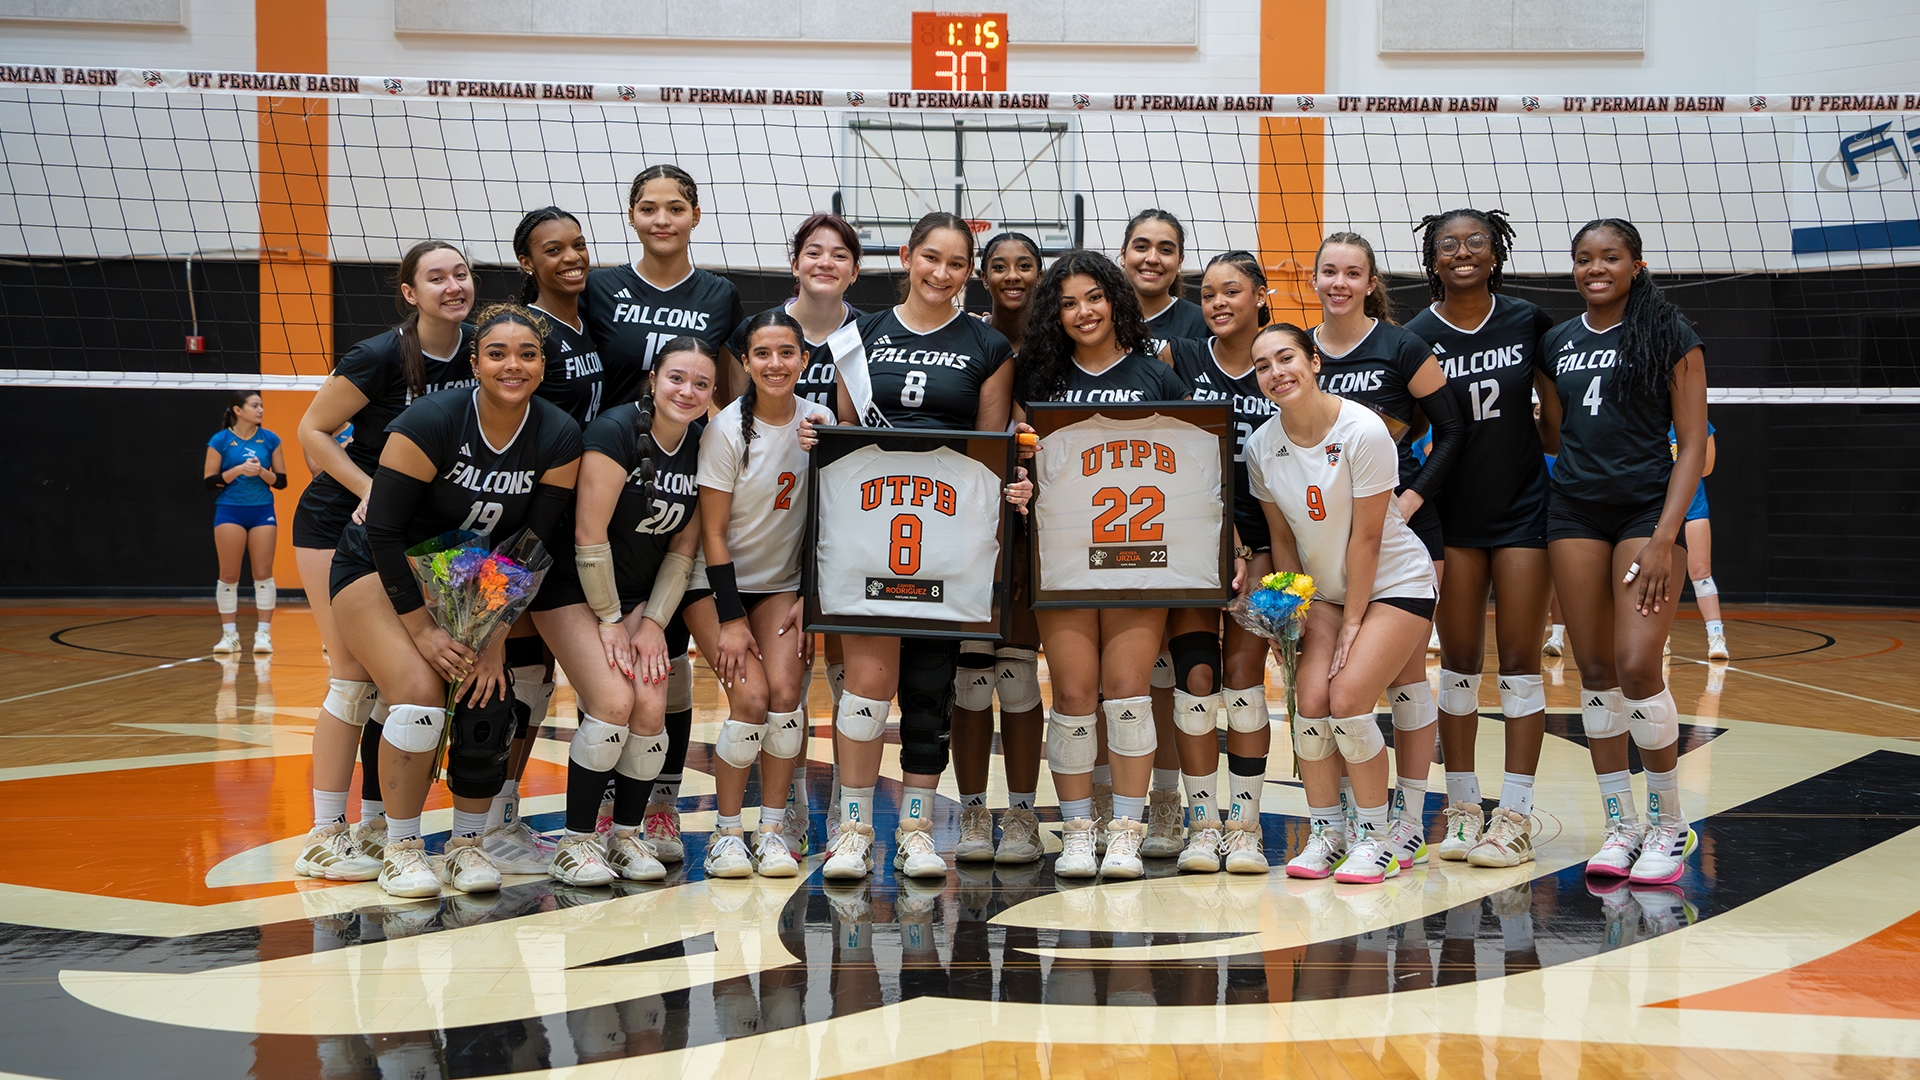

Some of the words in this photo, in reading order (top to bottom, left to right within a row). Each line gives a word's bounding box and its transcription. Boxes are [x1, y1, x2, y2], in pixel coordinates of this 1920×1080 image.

[948, 21, 999, 48] 1:15
[62, 68, 117, 86] BASIN
[187, 72, 212, 88] UT
[218, 73, 300, 91] PERMIAN
[306, 76, 360, 93] BASIN
[935, 51, 986, 91] 30
[427, 80, 451, 96] UT
[456, 81, 537, 99] PERMIAN
[542, 83, 594, 100] BASIN
[659, 87, 684, 103] UT
[688, 88, 768, 105] PERMIAN
[772, 90, 823, 106] BASIN
[888, 92, 911, 108] UT
[916, 92, 994, 109] PERMIAN
[998, 93, 1050, 109] BASIN
[1113, 95, 1137, 111] UT
[1141, 95, 1218, 112] PERMIAN
[1223, 96, 1274, 111] BASIN
[1337, 96, 1361, 112] UT
[1365, 97, 1442, 113] PERMIAN
[1447, 97, 1499, 112] BASIN
[1563, 97, 1587, 112] UT
[1590, 96, 1670, 113] PERMIAN
[1673, 97, 1726, 112] BASIN
[1790, 95, 1815, 111] UT
[1818, 95, 1900, 112] PERMIAN
[613, 303, 710, 331] FALCONS
[867, 347, 971, 370] FALCONS
[584, 380, 603, 422] 14
[900, 370, 928, 408] 8
[1468, 378, 1501, 421] 12
[1583, 375, 1603, 416] 4
[1081, 440, 1176, 477] UTPB
[443, 461, 535, 494] FALCONS
[773, 471, 796, 511] 2
[861, 475, 957, 516] UTPB
[1307, 485, 1327, 521] 9
[459, 501, 504, 537] 19
[635, 499, 685, 535] 20
[1092, 485, 1165, 543] 22
[888, 513, 923, 576] 8
[1150, 550, 1166, 562] 22
[885, 586, 927, 595] RODRIGUEZ
[931, 585, 939, 597] 8
